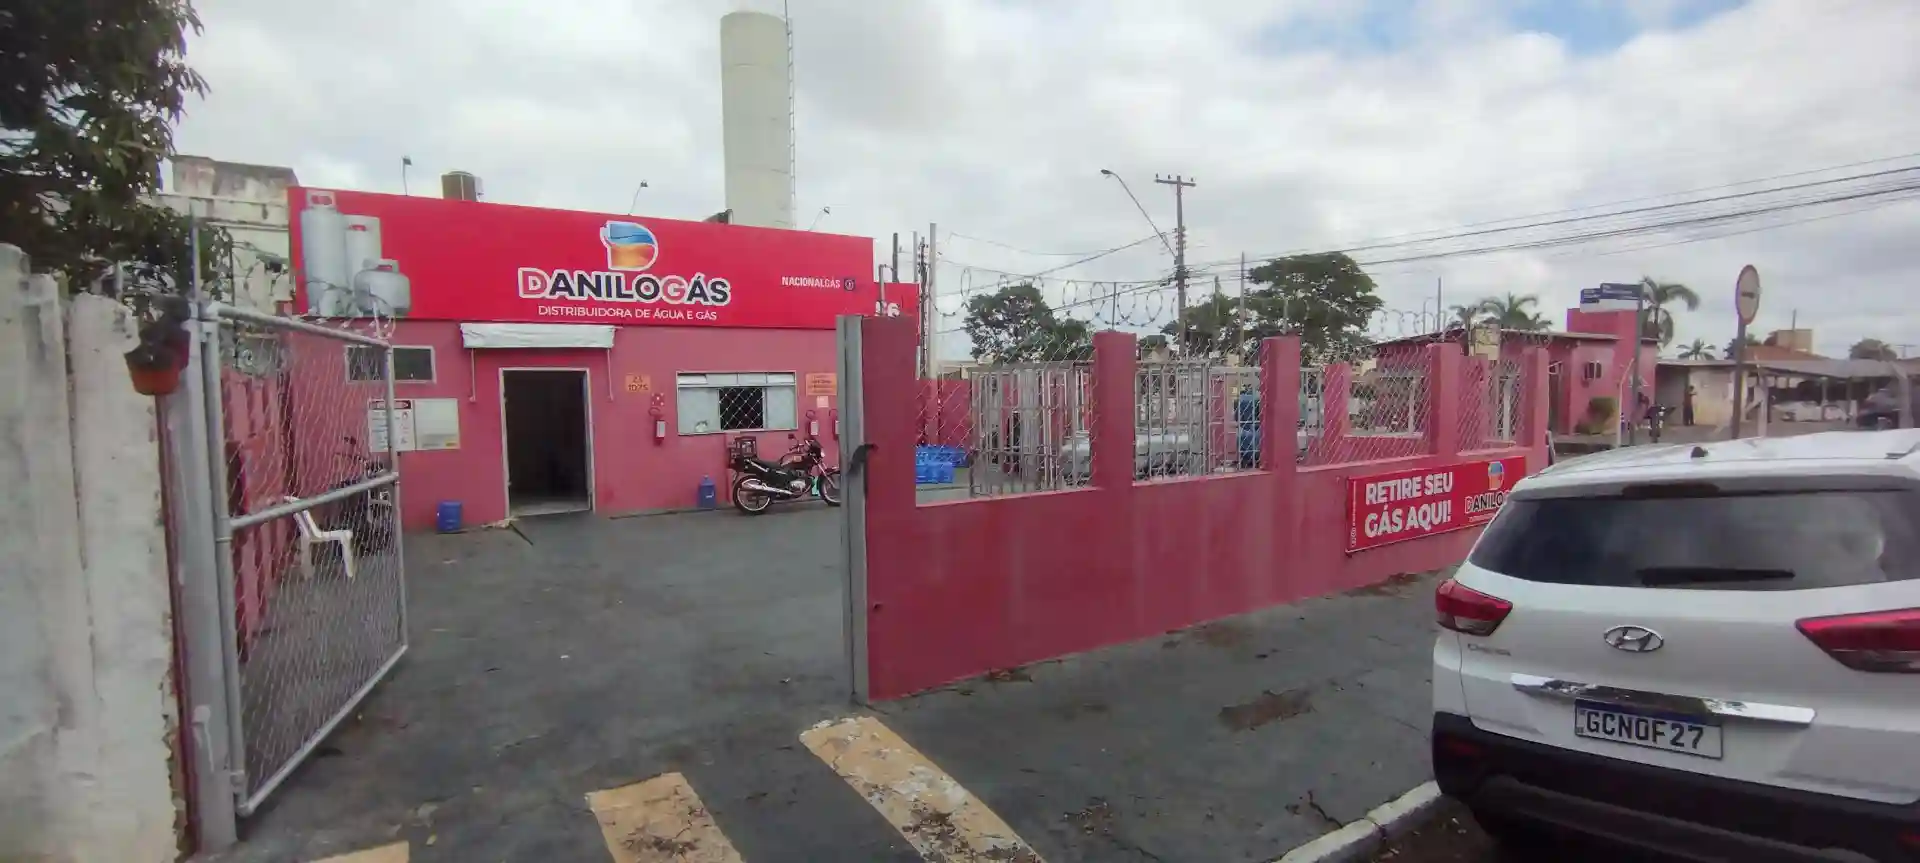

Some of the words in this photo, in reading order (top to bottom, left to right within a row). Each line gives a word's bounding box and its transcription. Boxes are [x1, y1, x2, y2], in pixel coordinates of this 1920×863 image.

[518, 267, 731, 306] DANILOGÁS
[538, 305, 633, 319] DISTRIBUIDORA
[635, 308, 651, 319] DE
[654, 307, 685, 320] ÁGUA
[687, 310, 694, 320] E
[1364, 475, 1423, 506] RETIRE
[1424, 471, 1454, 496] SEU
[1464, 489, 1511, 514] DANILO
[1364, 503, 1403, 538] GÁS
[1405, 499, 1452, 531] AQUI!
